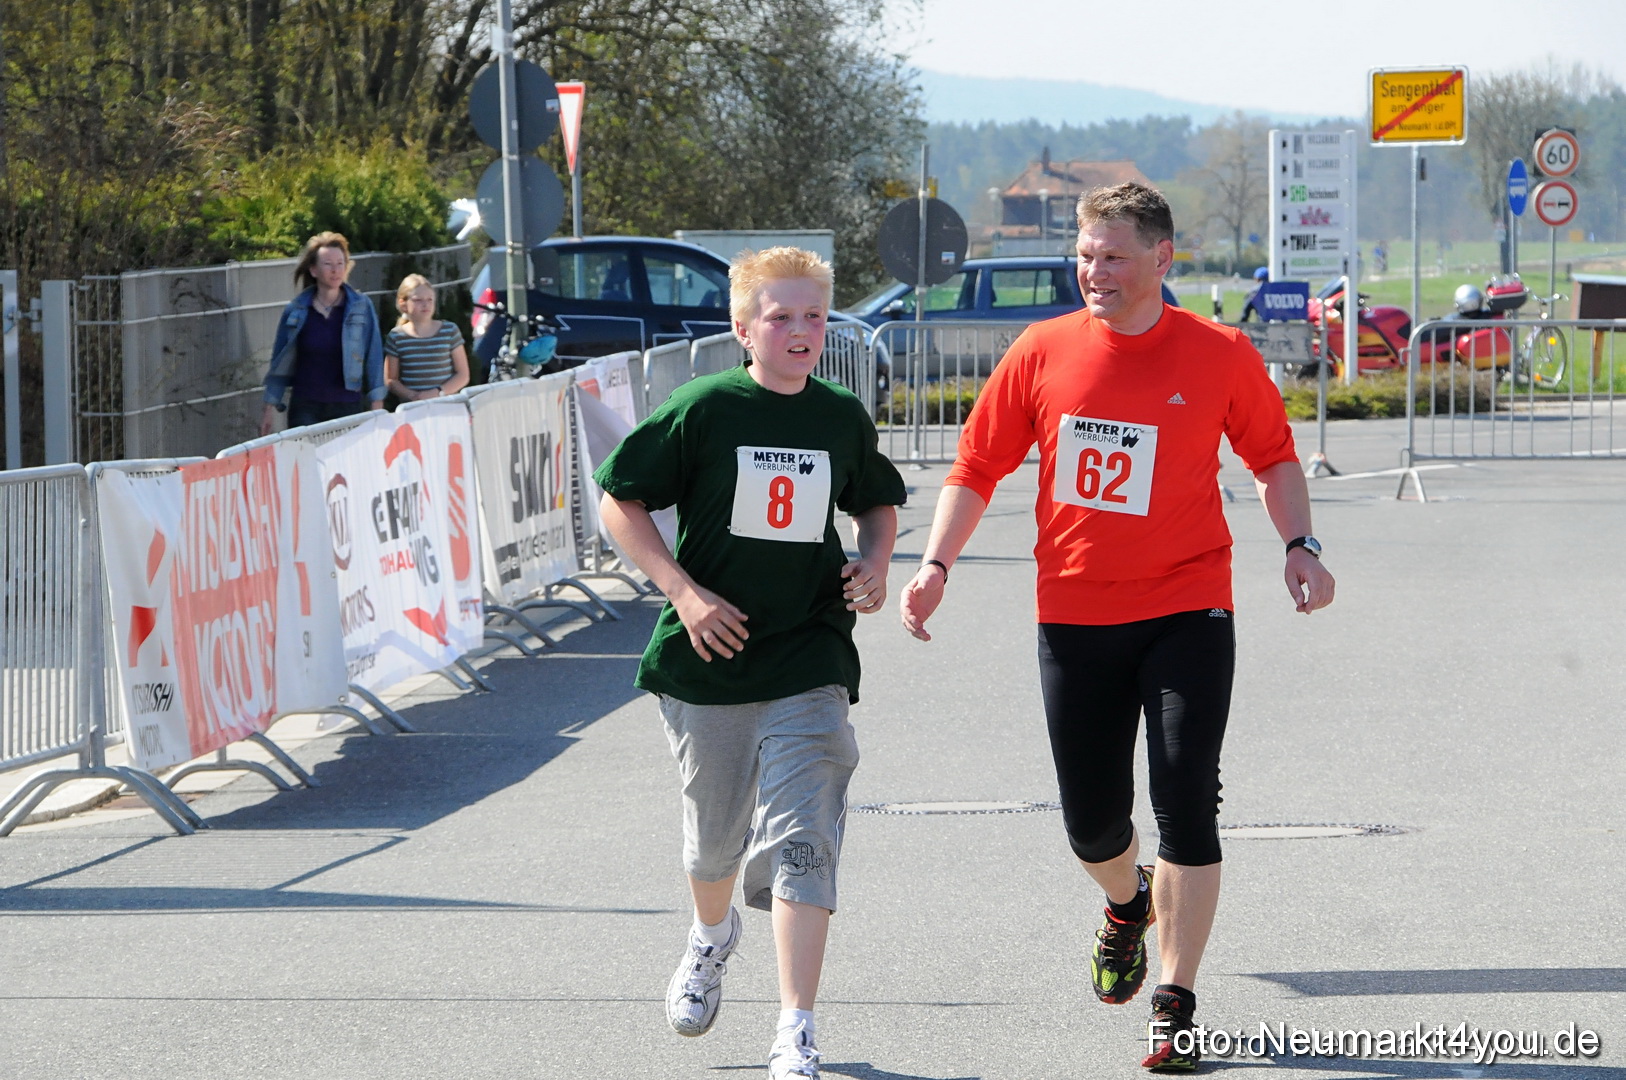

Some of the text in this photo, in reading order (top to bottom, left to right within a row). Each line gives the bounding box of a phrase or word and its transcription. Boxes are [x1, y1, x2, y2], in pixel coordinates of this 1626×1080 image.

[1381, 79, 1456, 101] Sengenthal
[1391, 102, 1446, 114] am Anger
[1546, 144, 1570, 165] 60
[1290, 234, 1317, 250] THULE
[1264, 293, 1304, 309] VOLVO
[1074, 420, 1119, 435] MEYER
[1073, 431, 1119, 444] WERBUNG
[753, 451, 796, 464] MEYER
[753, 462, 797, 473] WERBUNG
[1075, 447, 1132, 504] 62
[767, 475, 795, 530] 8
